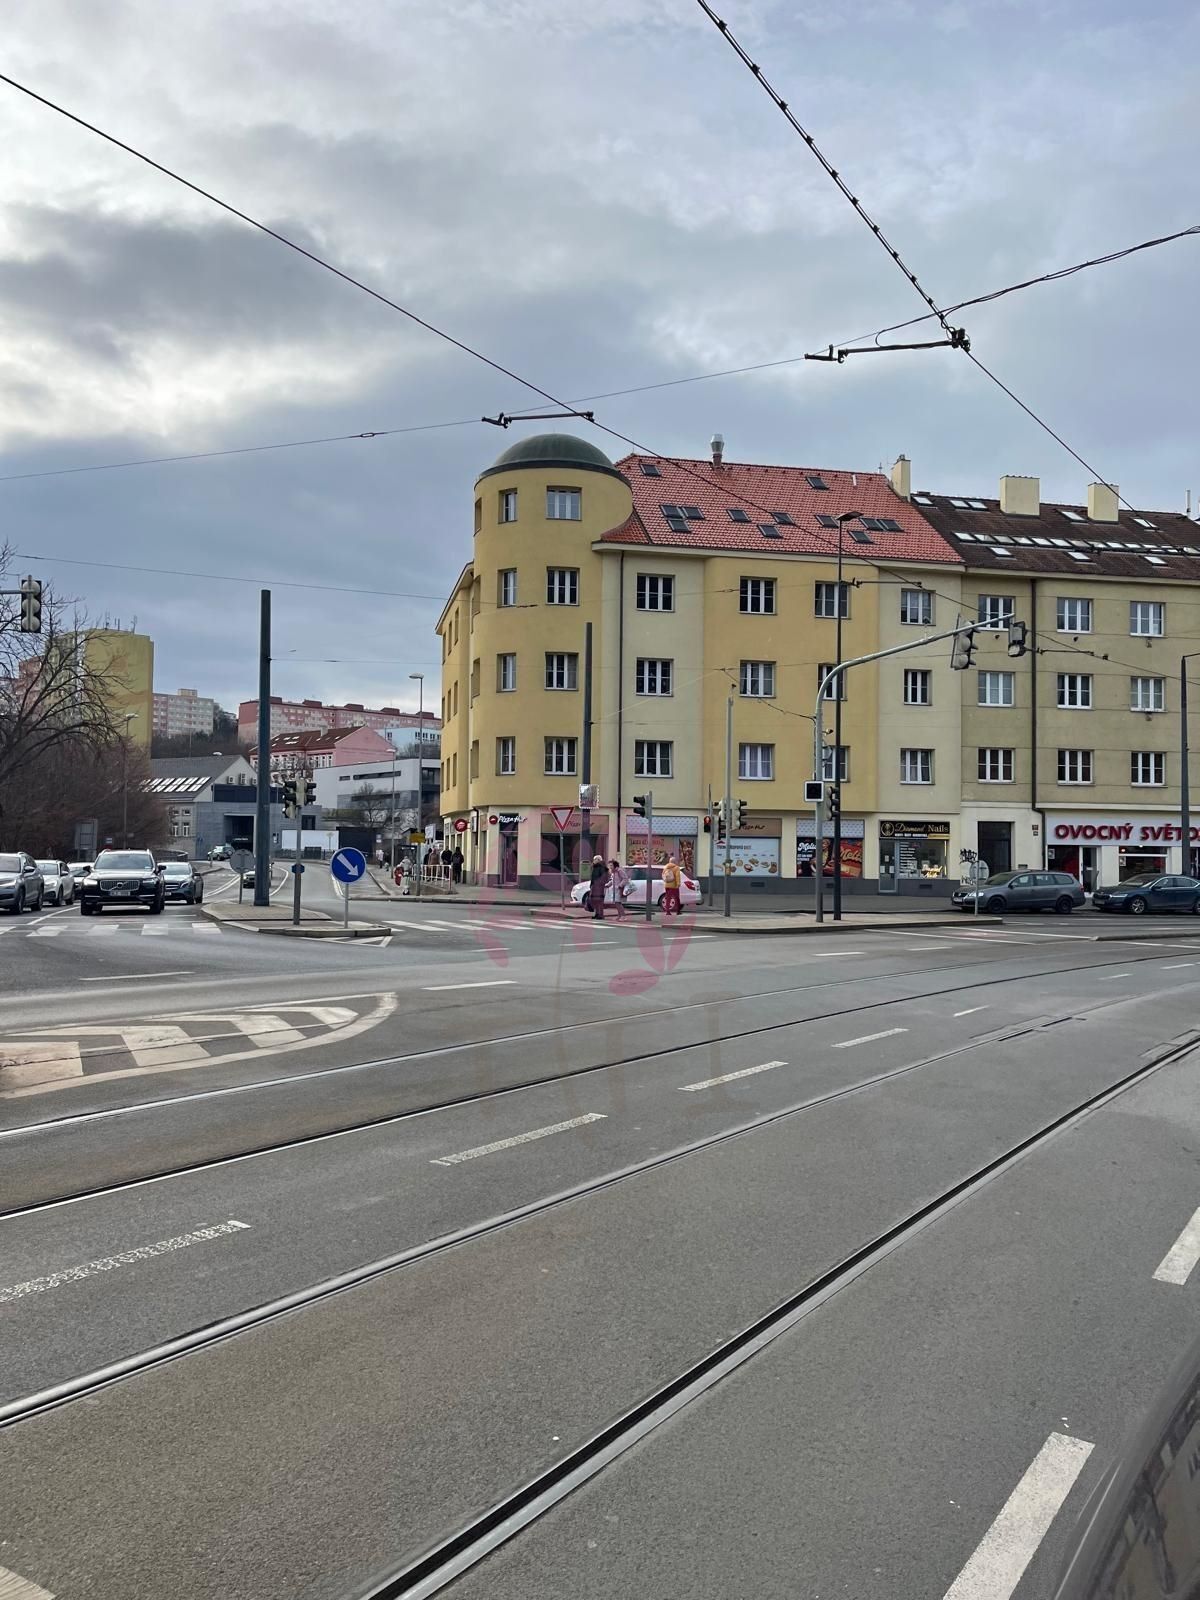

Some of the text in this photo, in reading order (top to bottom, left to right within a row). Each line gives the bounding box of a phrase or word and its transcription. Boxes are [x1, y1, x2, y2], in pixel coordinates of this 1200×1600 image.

[895, 823, 949, 832] Diamond Nails
[1055, 822, 1200, 841] OVOCNÝ SVĚTO
